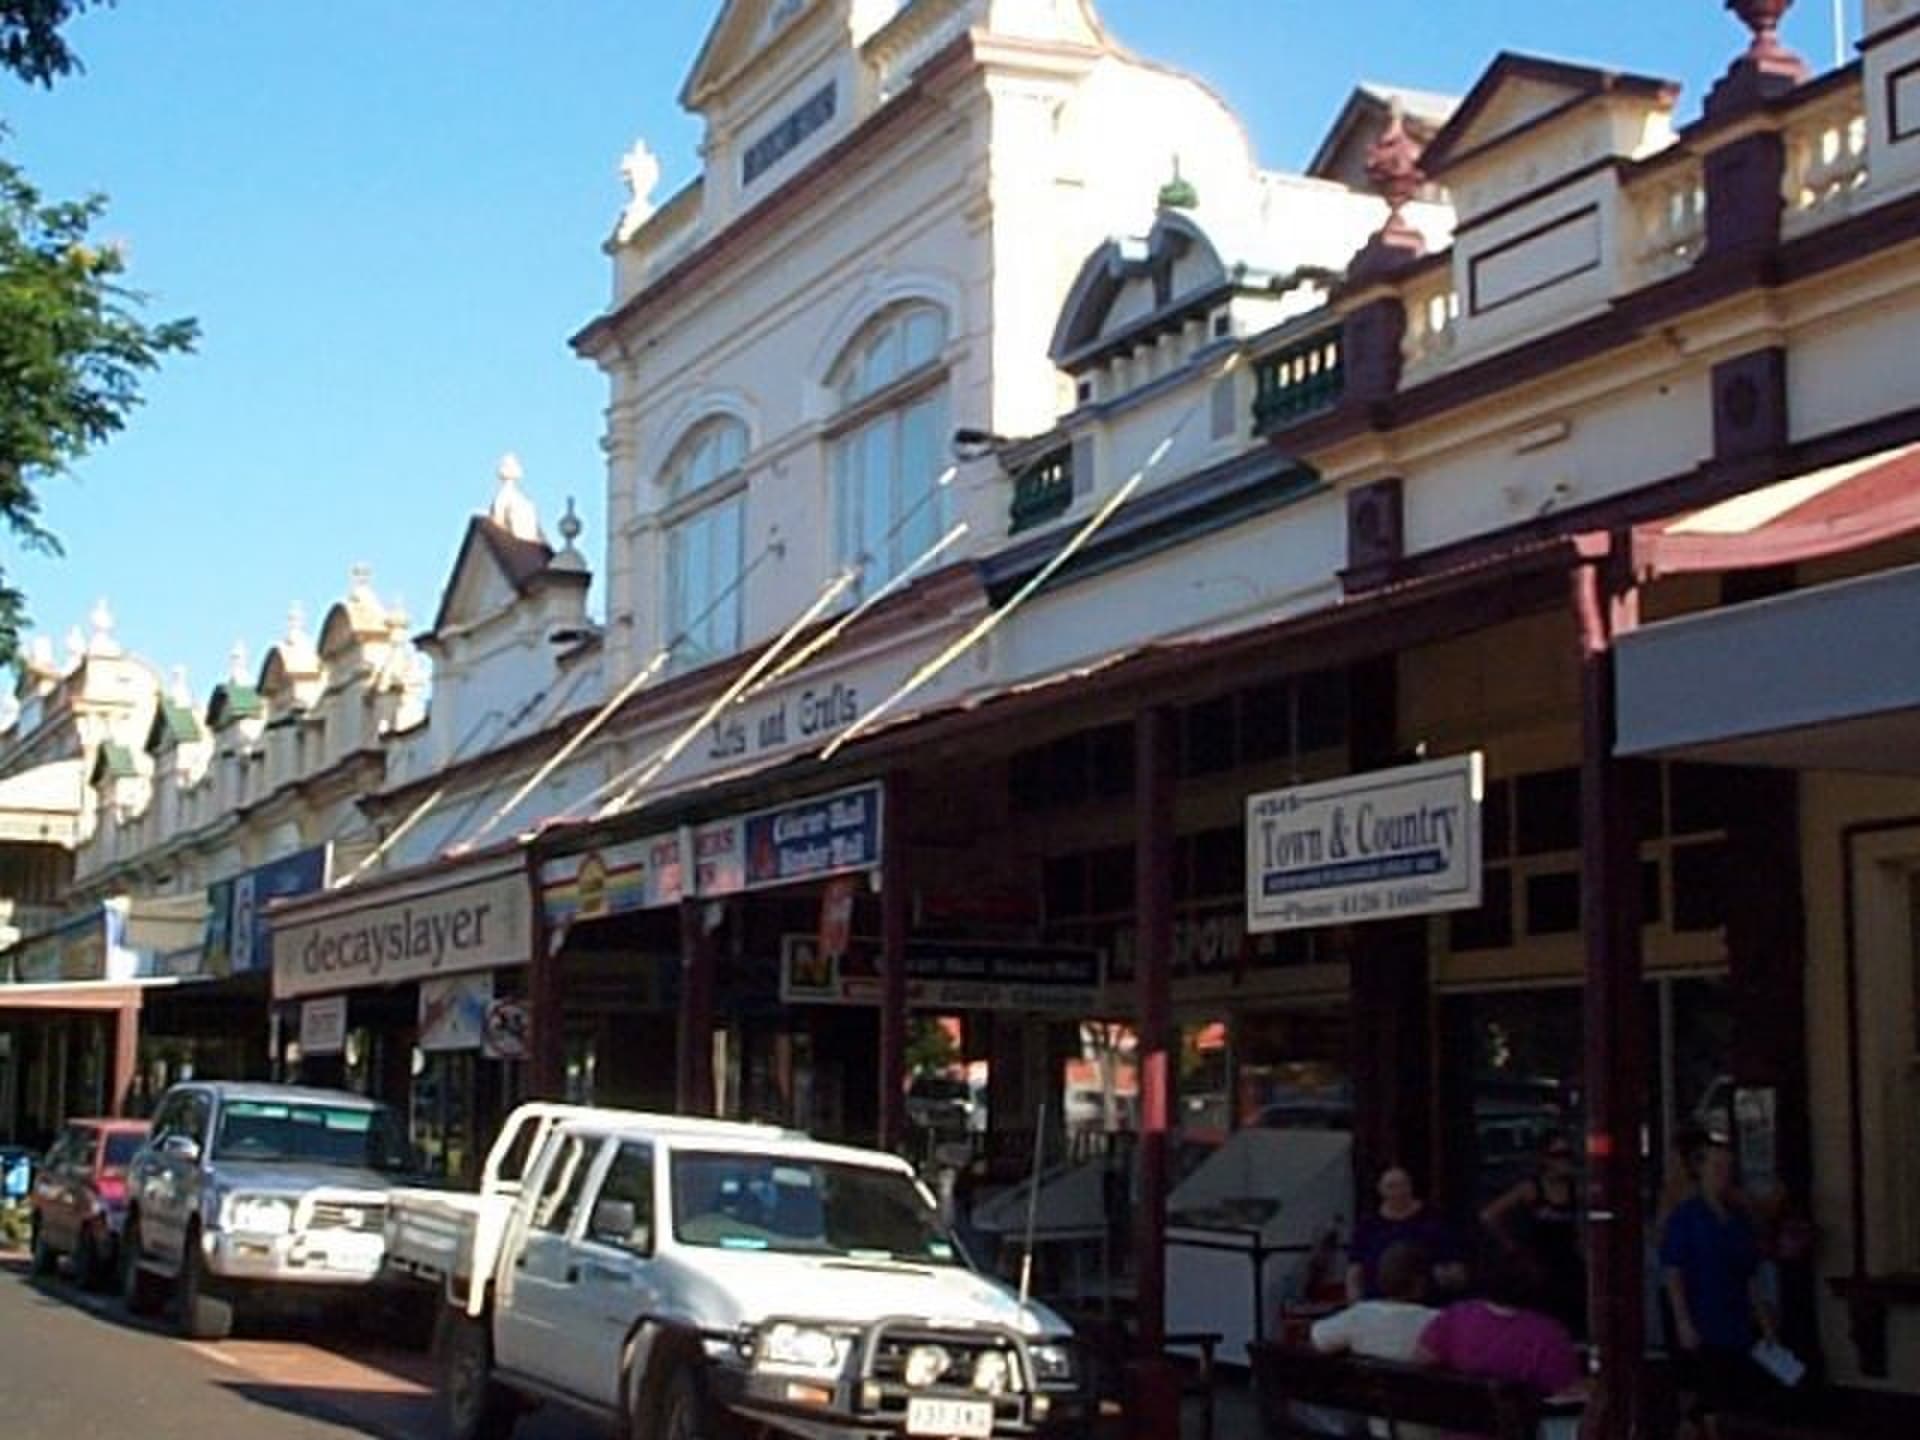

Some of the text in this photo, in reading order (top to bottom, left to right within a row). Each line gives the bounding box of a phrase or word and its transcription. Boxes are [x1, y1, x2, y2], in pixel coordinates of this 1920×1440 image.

[1261, 819, 1322, 868] Town
[1330, 805, 1348, 859] &
[1355, 802, 1458, 854] Country
[302, 903, 492, 975] decayslayer
